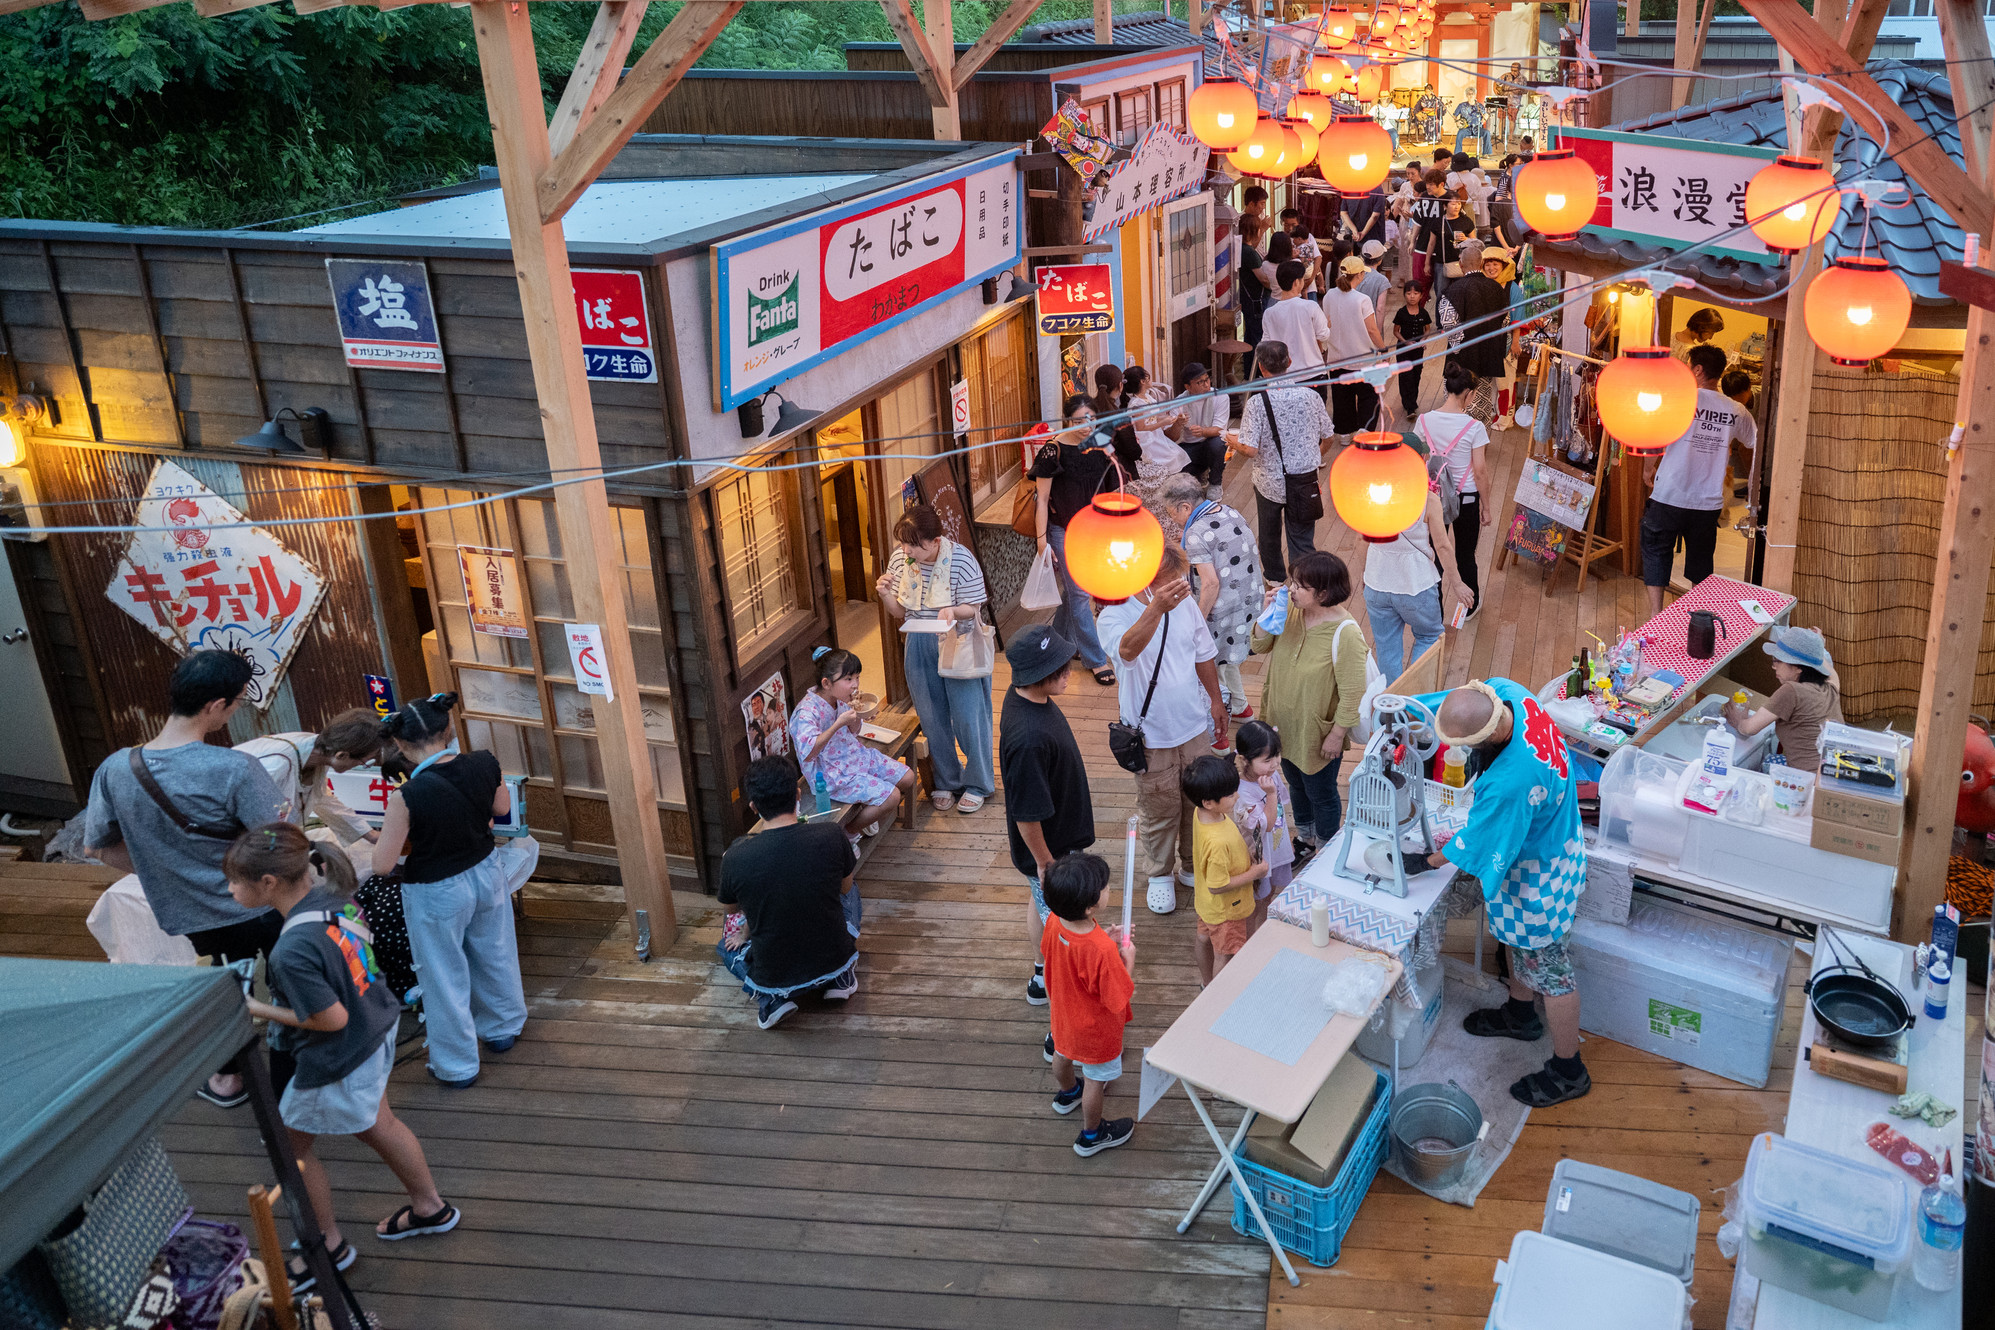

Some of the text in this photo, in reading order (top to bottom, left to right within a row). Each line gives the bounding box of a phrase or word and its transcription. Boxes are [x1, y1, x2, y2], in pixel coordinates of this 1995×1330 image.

[1116, 161, 1187, 212] 山本理容所
[978, 190, 986, 240] 日用品
[848, 204, 940, 280] たばこ
[759, 269, 790, 292] Drink
[1042, 270, 1108, 310] たばこ
[358, 274, 419, 331] 塩
[573, 288, 644, 345] ばこ
[750, 295, 797, 342] Fanta
[871, 284, 920, 322] わかまつ
[1044, 314, 1109, 331] フコク生命
[359, 348, 437, 360] オリエントファイナンス
[743, 337, 801, 372] オレンジ・グレープ
[155, 485, 195, 497] ヨクキク
[124, 555, 302, 628] キンチョール
[486, 556, 505, 610] 入居募集
[374, 696, 391, 717] と
